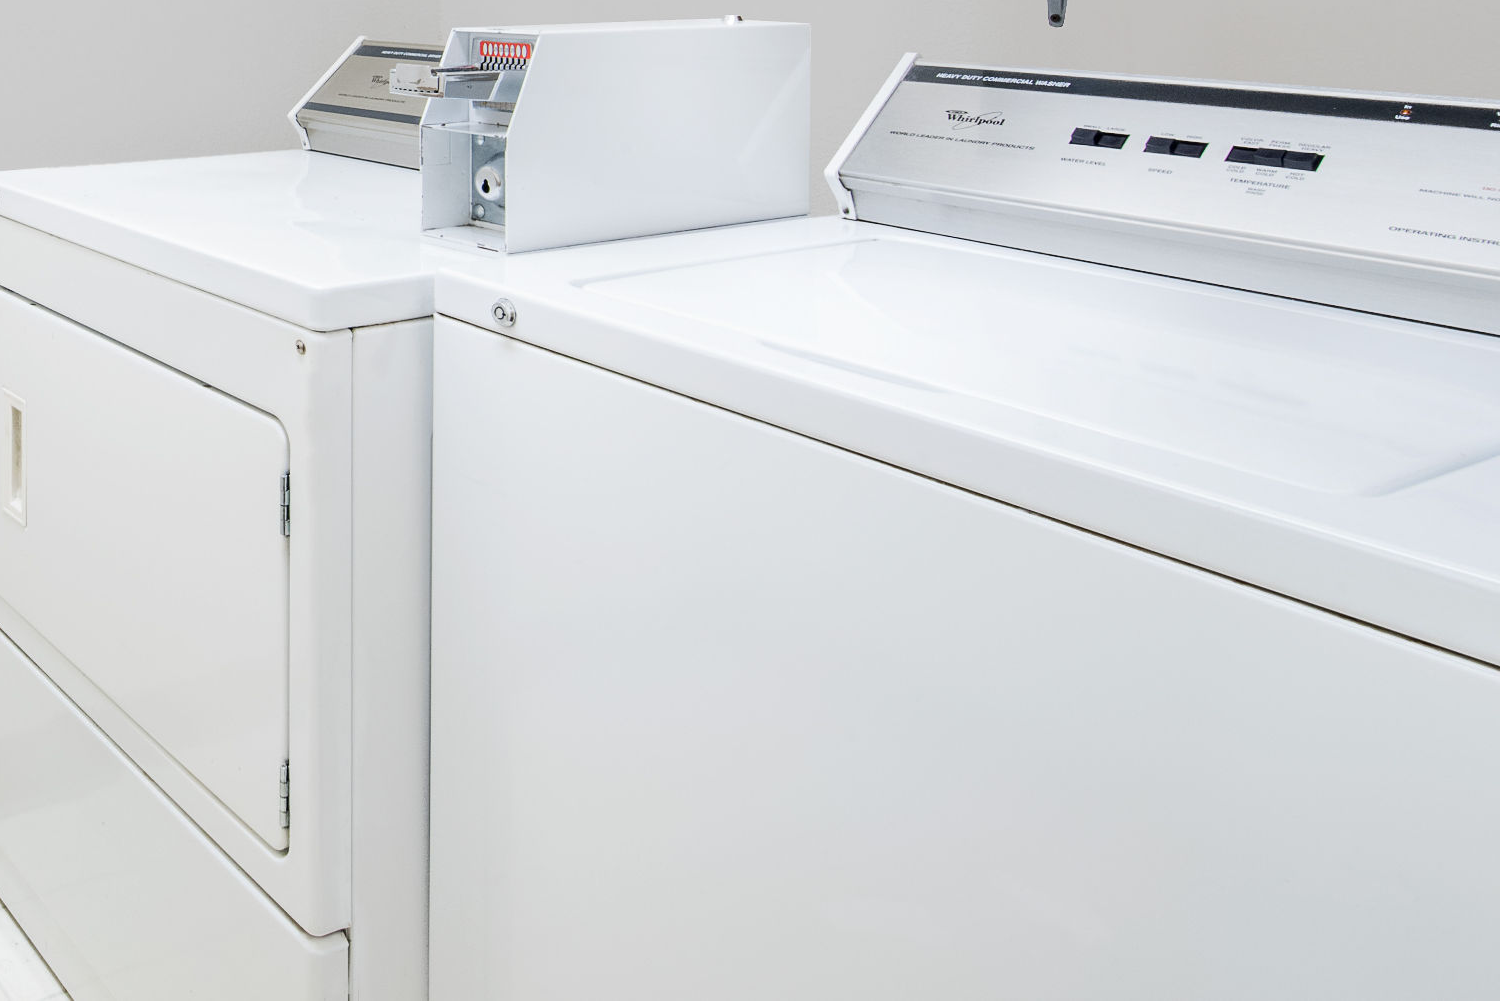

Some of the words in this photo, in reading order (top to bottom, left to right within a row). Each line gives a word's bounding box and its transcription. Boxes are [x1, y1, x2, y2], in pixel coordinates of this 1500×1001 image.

[982, 75, 1033, 85] COMMERCIAL
[1035, 80, 1071, 88] WASHER
[947, 113, 1006, 126] Whirlpool
[955, 138, 991, 146] LAUNDRY
[991, 142, 1036, 150] PRODUCTS
[1230, 178, 1291, 190] TEMPERATURE
[1388, 226, 1457, 239] OPERATING
